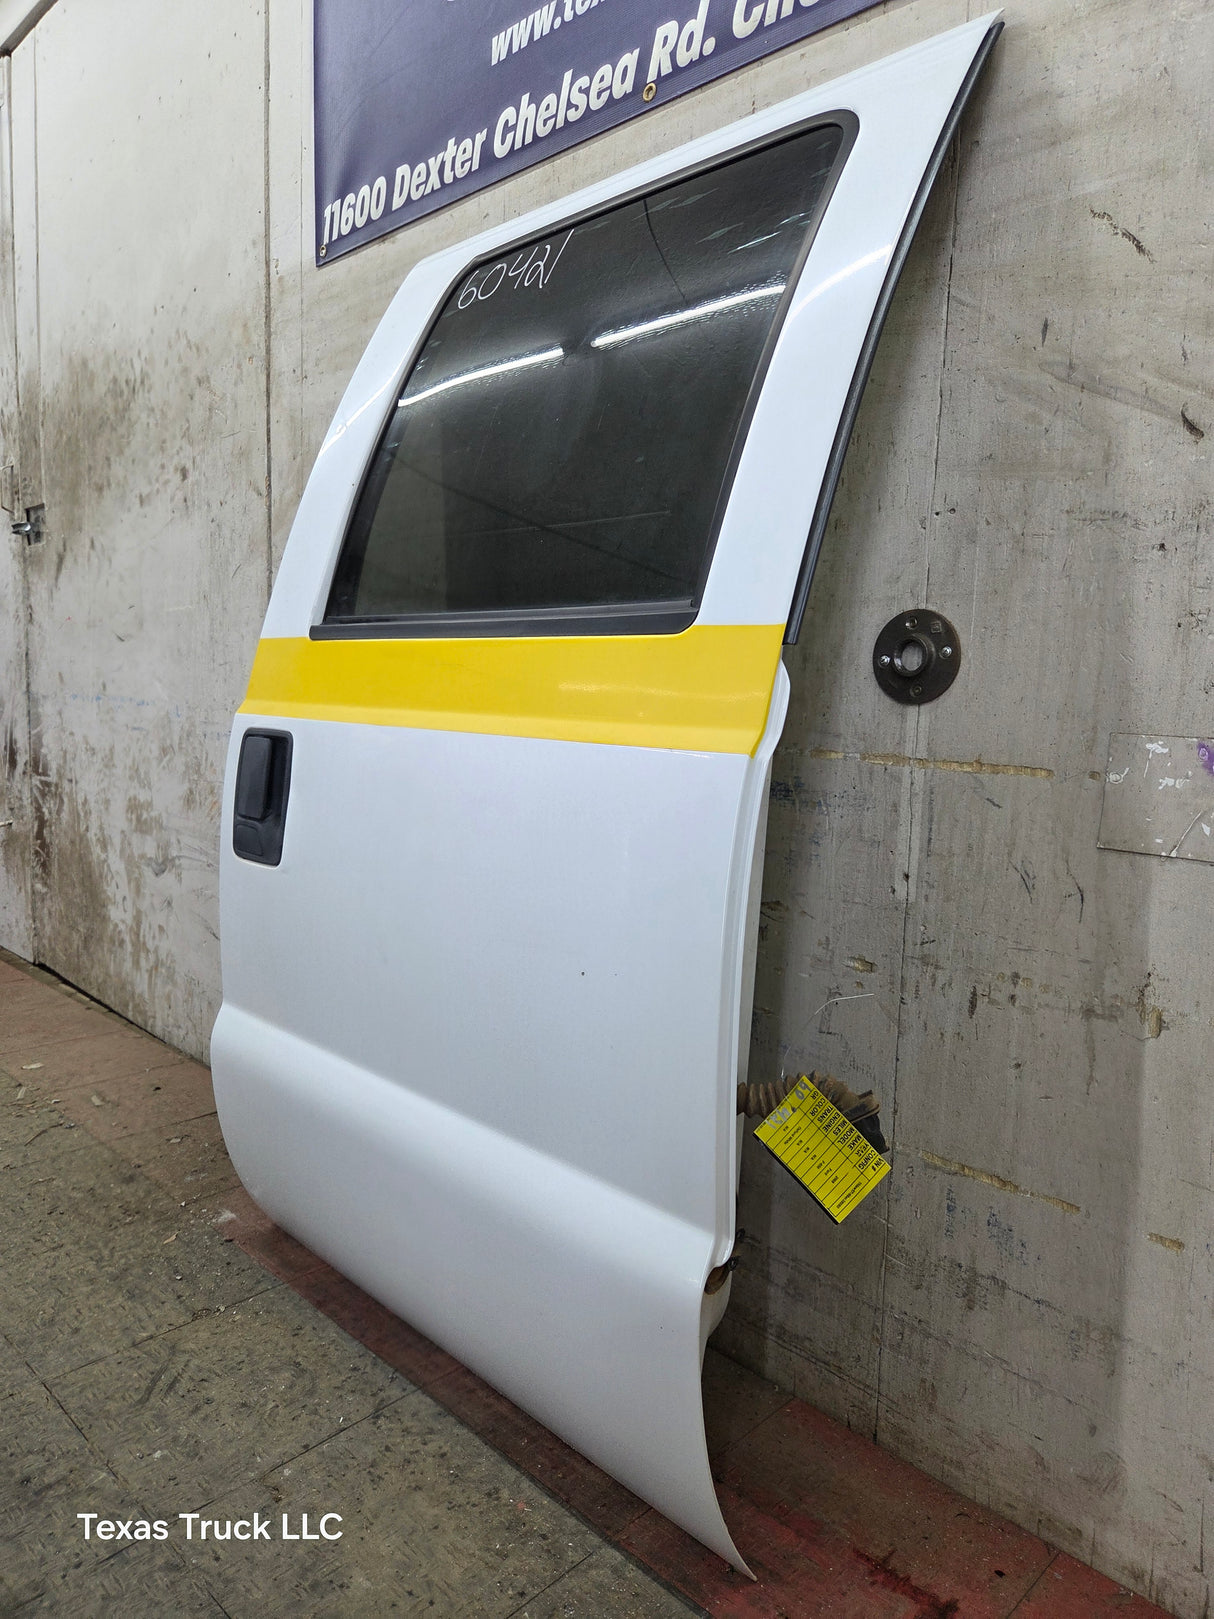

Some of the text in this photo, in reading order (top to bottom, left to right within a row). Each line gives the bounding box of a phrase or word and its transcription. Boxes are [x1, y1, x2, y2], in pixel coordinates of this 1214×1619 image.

[322, 176, 387, 246] 11600
[392, 136, 485, 212] Dexter
[493, 46, 640, 160] Chelsea
[646, 0, 716, 83] Rd.
[457, 228, 575, 309] 60421
[809, 1097, 826, 1117] COLOR
[817, 1105, 834, 1123] TRANS
[822, 1112, 841, 1133] ENGINE
[833, 1119, 848, 1136] MILES
[837, 1127, 855, 1146] MODEL
[847, 1134, 862, 1151] MAKE
[855, 1142, 869, 1157] YEAR
[857, 1149, 877, 1170] CONFIG
